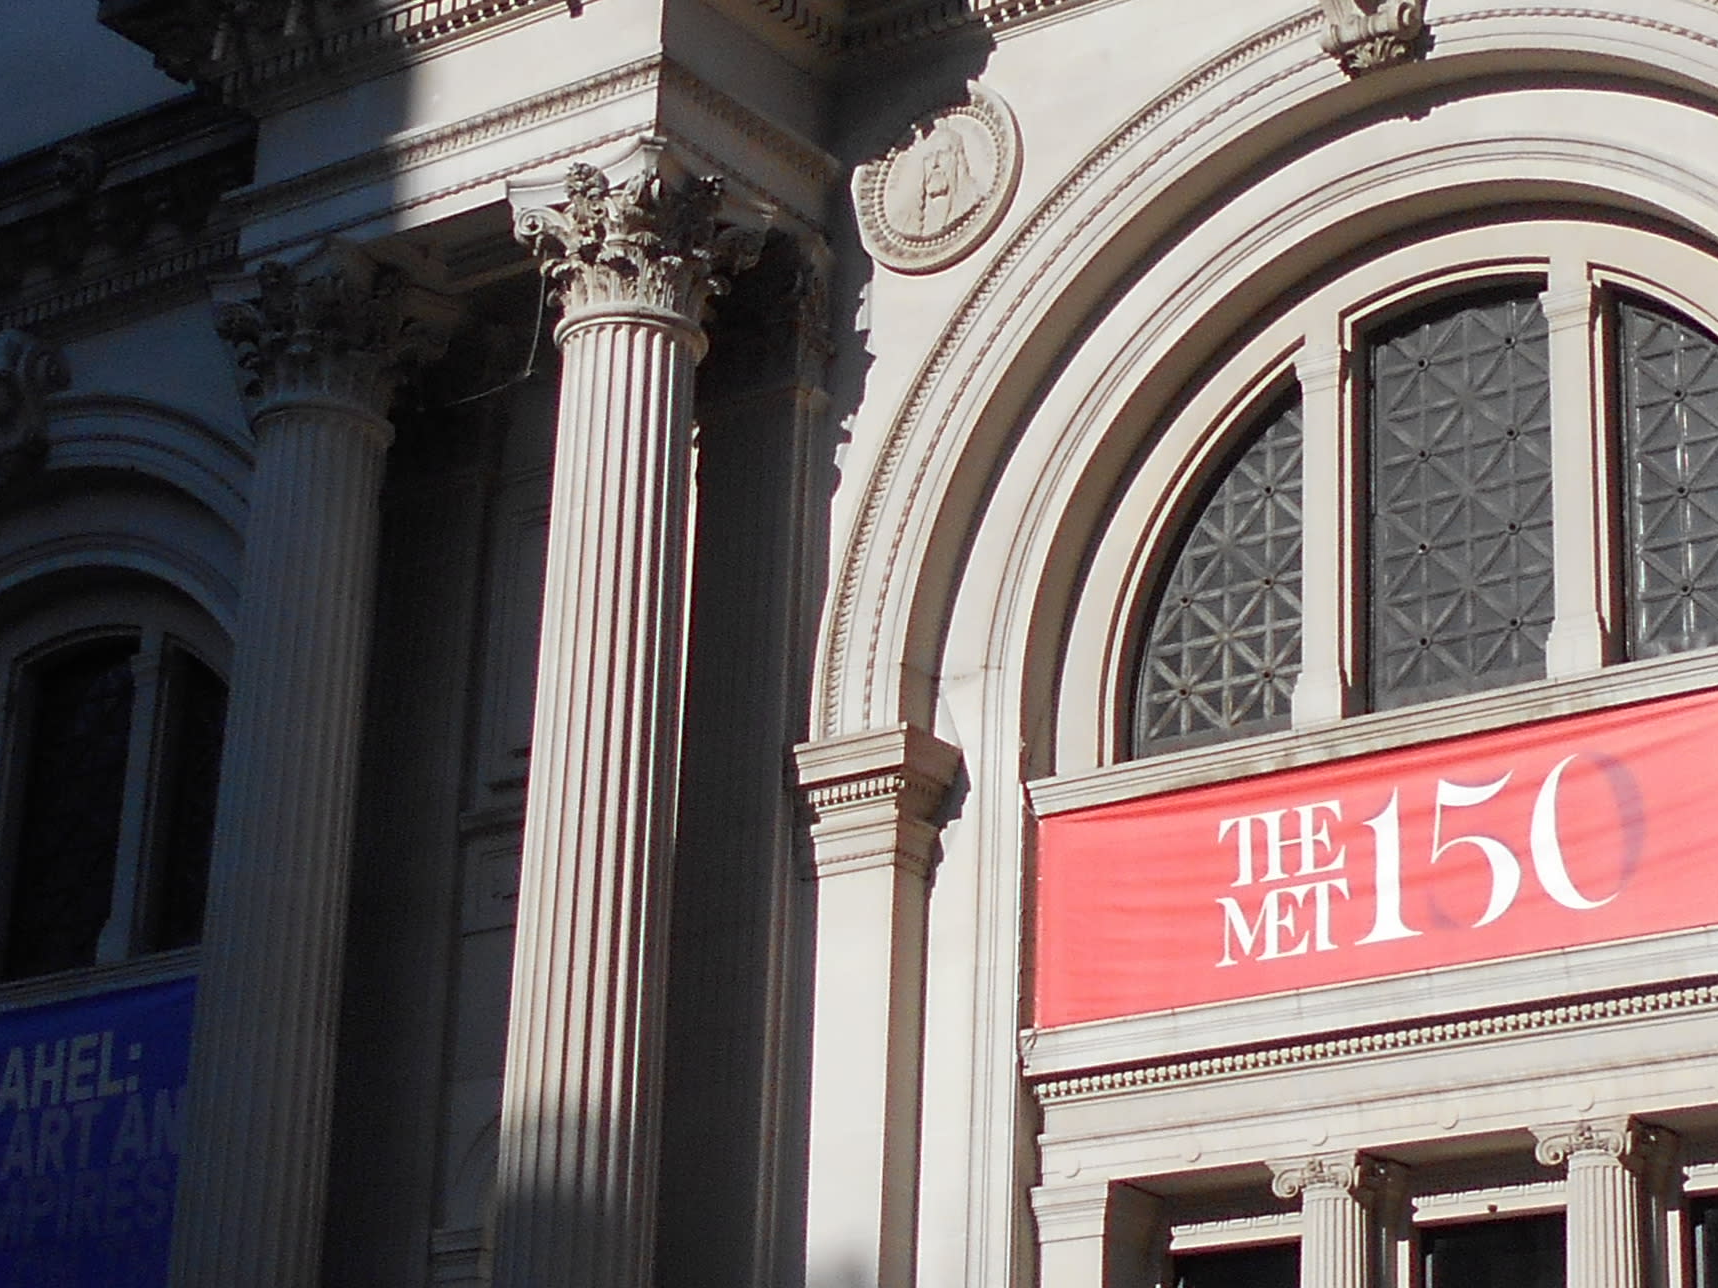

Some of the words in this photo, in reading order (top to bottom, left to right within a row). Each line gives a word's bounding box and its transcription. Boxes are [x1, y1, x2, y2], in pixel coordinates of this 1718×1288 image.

[1217, 799, 1349, 889] THE
[1354, 753, 1645, 945] 150
[1215, 877, 1351, 968] MET
[0, 1100, 103, 1181] ART
[110, 1085, 182, 1150] AN
